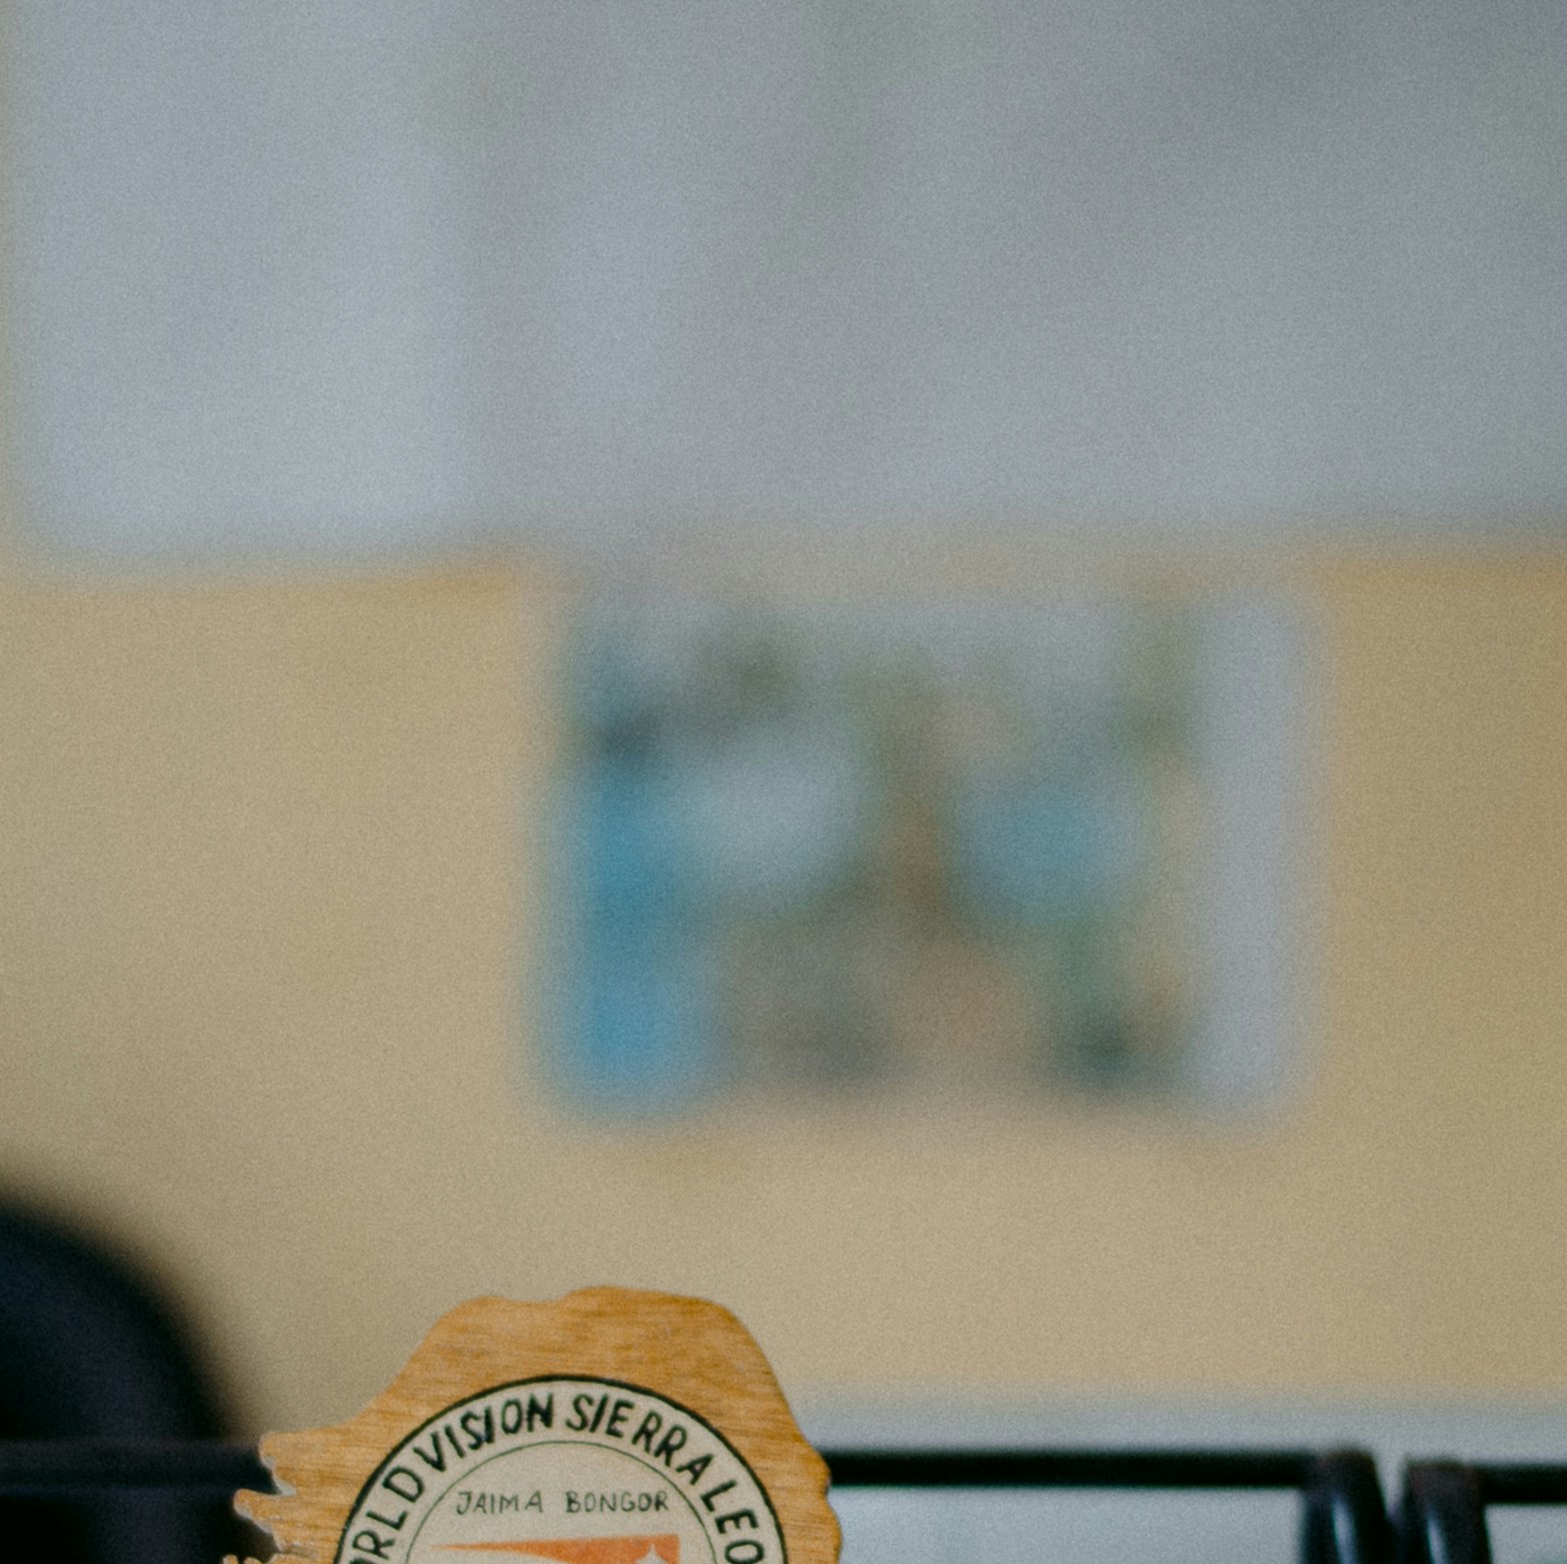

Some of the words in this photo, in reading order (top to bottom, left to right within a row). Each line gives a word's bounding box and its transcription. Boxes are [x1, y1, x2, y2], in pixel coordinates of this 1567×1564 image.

[413, 1392, 554, 1473] VISION
[565, 1393, 714, 1486] SIERRA
[456, 1489, 544, 1516] JAIMA
[565, 1489, 670, 1515] BONGOR
